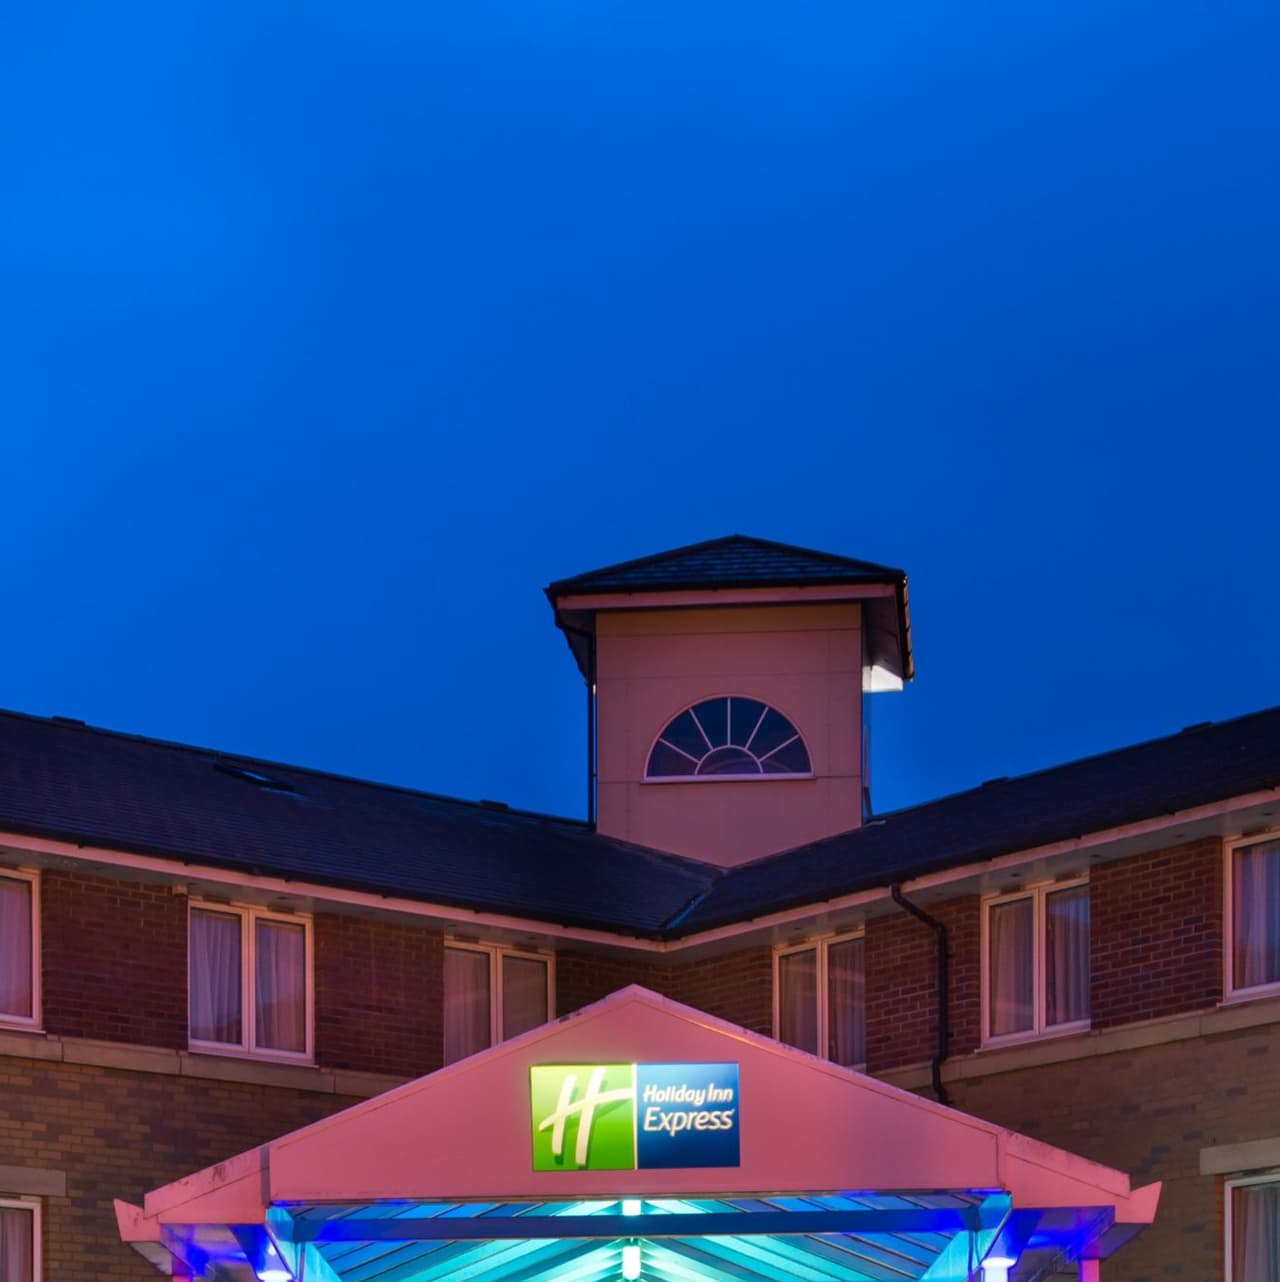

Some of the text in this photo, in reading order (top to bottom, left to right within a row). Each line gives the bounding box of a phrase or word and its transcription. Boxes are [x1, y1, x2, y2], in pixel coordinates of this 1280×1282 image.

[643, 1083, 734, 1106] Holiday Inn
[643, 1107, 735, 1137] Express
